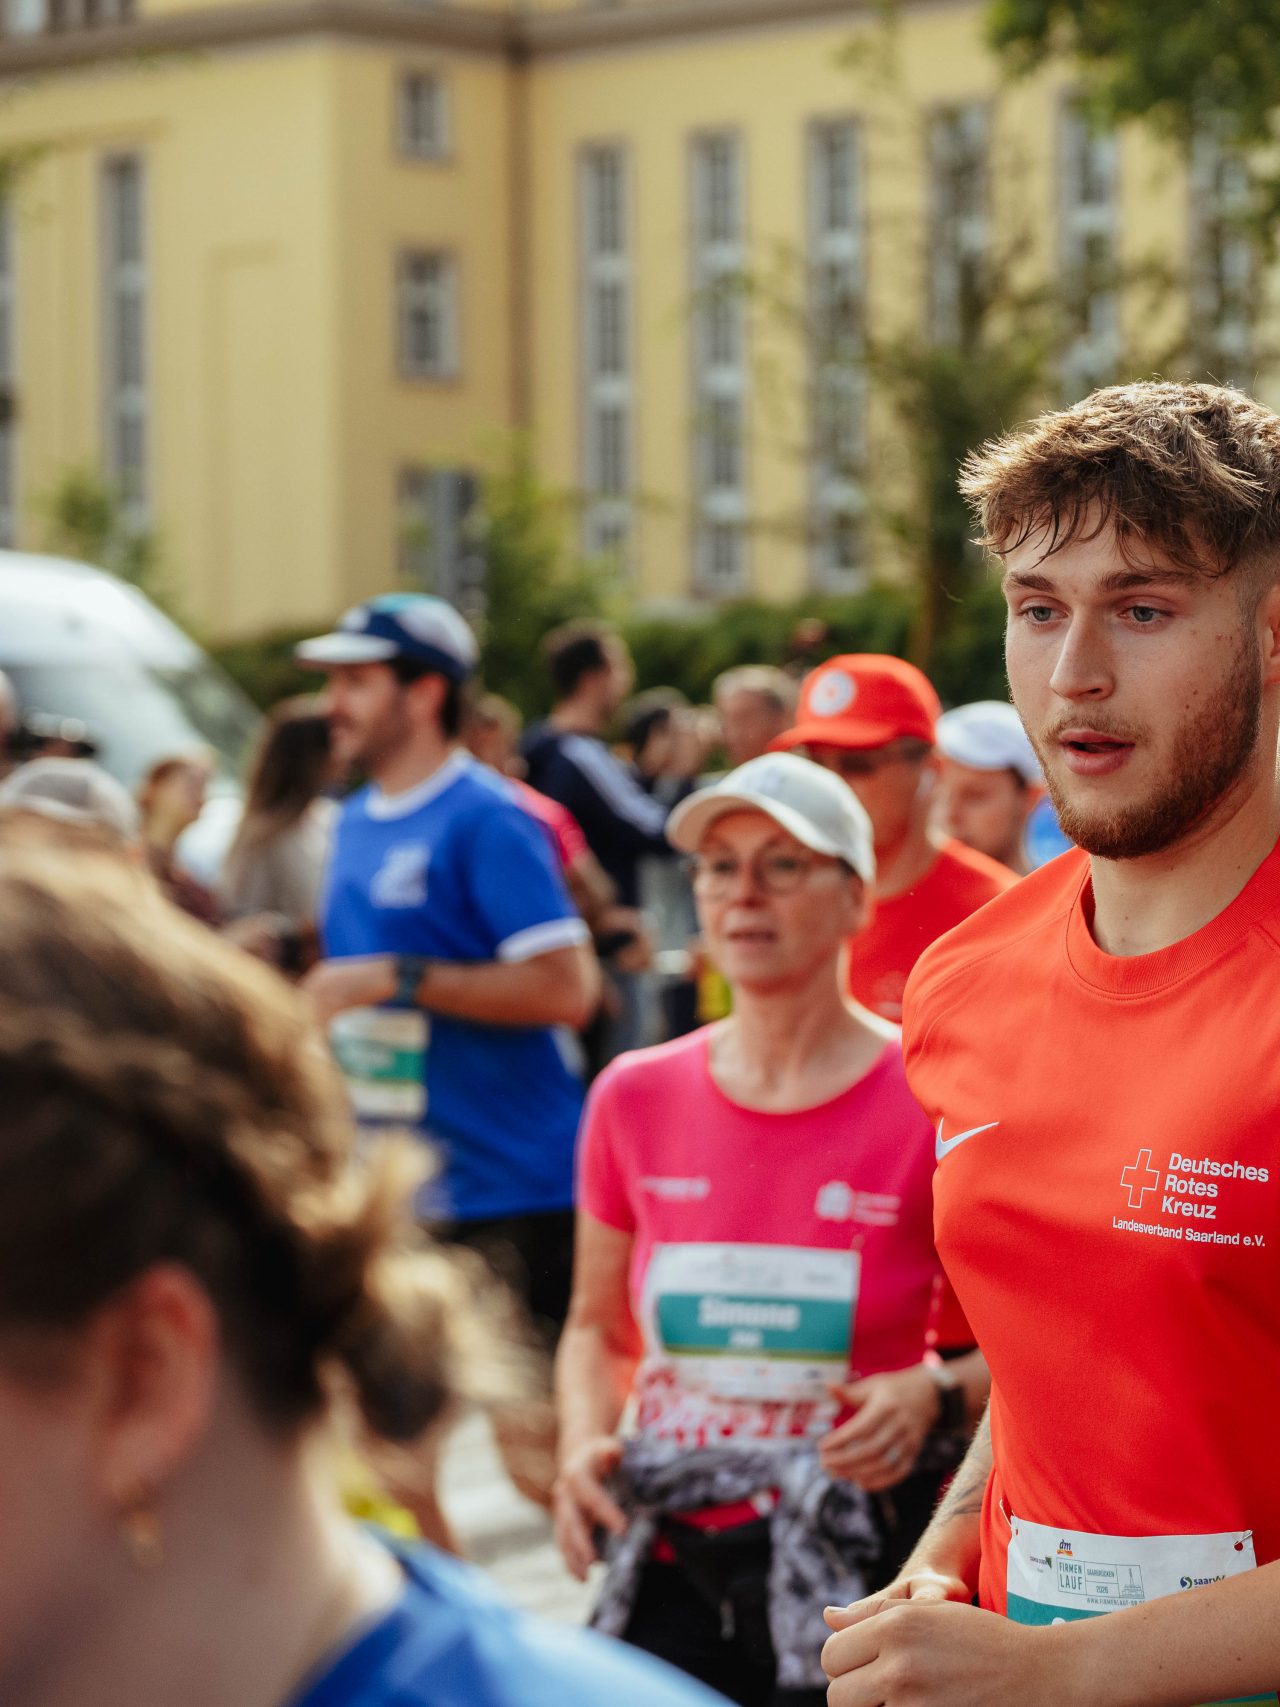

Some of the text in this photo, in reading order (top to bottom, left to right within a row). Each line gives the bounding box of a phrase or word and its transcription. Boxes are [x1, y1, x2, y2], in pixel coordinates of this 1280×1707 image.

[1168, 1152, 1269, 1183] Deutsches
[1164, 1174, 1219, 1198] Rotes
[1161, 1196, 1217, 1219] Kreuz
[1112, 1216, 1266, 1247] Landesverband Saarland e.V.
[1059, 1539, 1071, 1550] dm
[1059, 1562, 1082, 1574] FIRMEN
[1060, 1574, 1083, 1590] LAUF
